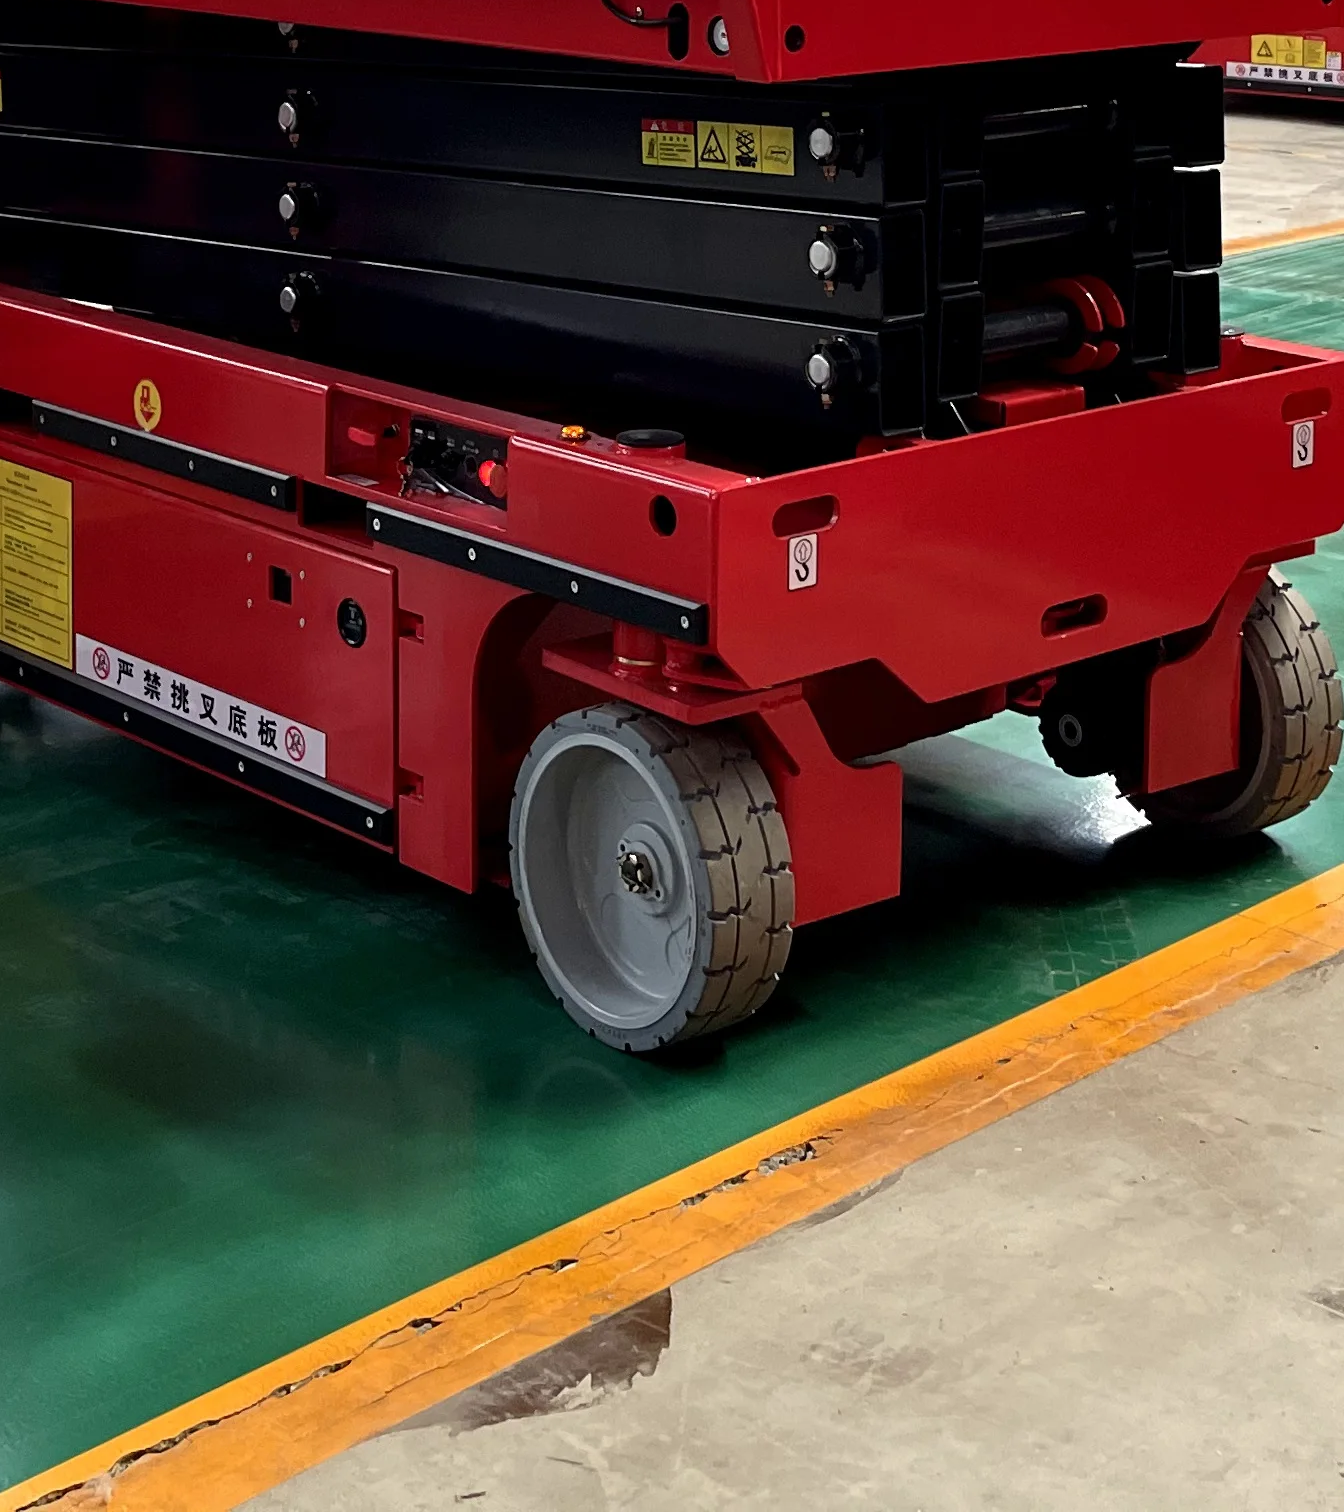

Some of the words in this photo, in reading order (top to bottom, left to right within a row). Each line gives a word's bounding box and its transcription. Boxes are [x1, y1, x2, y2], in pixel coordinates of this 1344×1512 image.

[116, 657, 278, 751] 严禁挑叉底板
